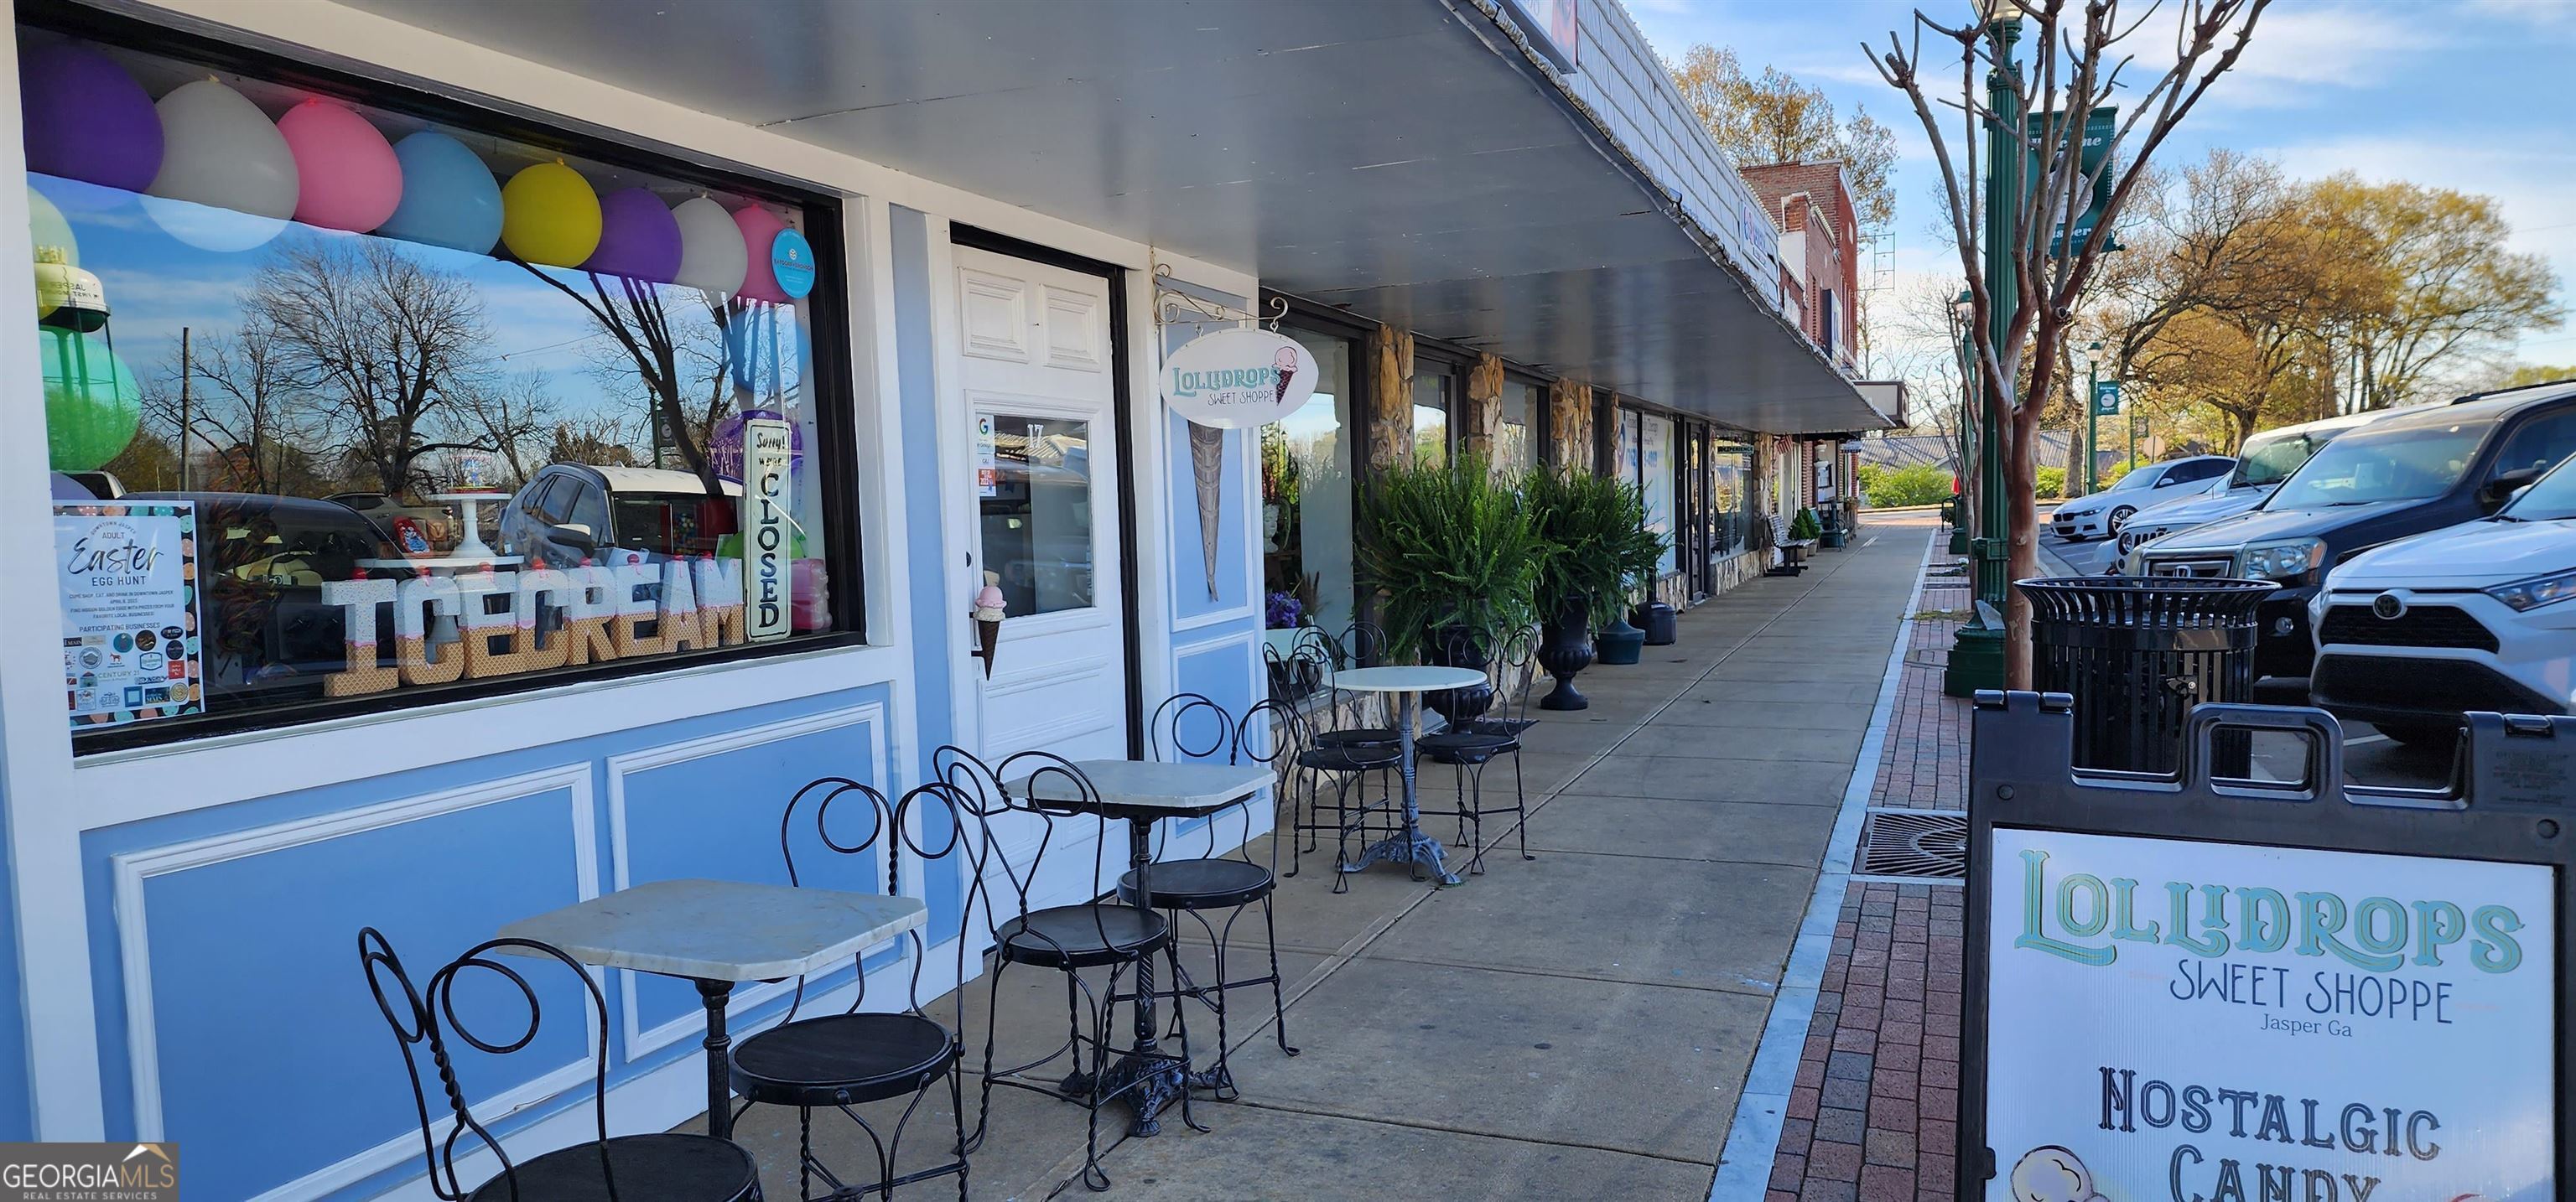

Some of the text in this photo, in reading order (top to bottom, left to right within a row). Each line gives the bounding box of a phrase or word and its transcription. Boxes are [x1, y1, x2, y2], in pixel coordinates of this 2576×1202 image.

[1172, 367, 1281, 397] LOLLIDROPS
[1208, 390, 1275, 406] SWEET SHOPPE
[756, 433, 785, 452] Sorry!
[1027, 423, 1044, 448] 17
[68, 537, 164, 574] Easter
[757, 473, 780, 628] CLOSED
[92, 576, 146, 586] EGG HUNT
[2014, 849, 2526, 974] LOLLIDROPS
[2170, 959, 2454, 1024] SWEET SHOPPE
[2260, 1013, 2352, 1038] Jasper Ga
[2098, 1066, 2442, 1162] NOSTALGIC
[2169, 1143, 2381, 1202] CANDY
